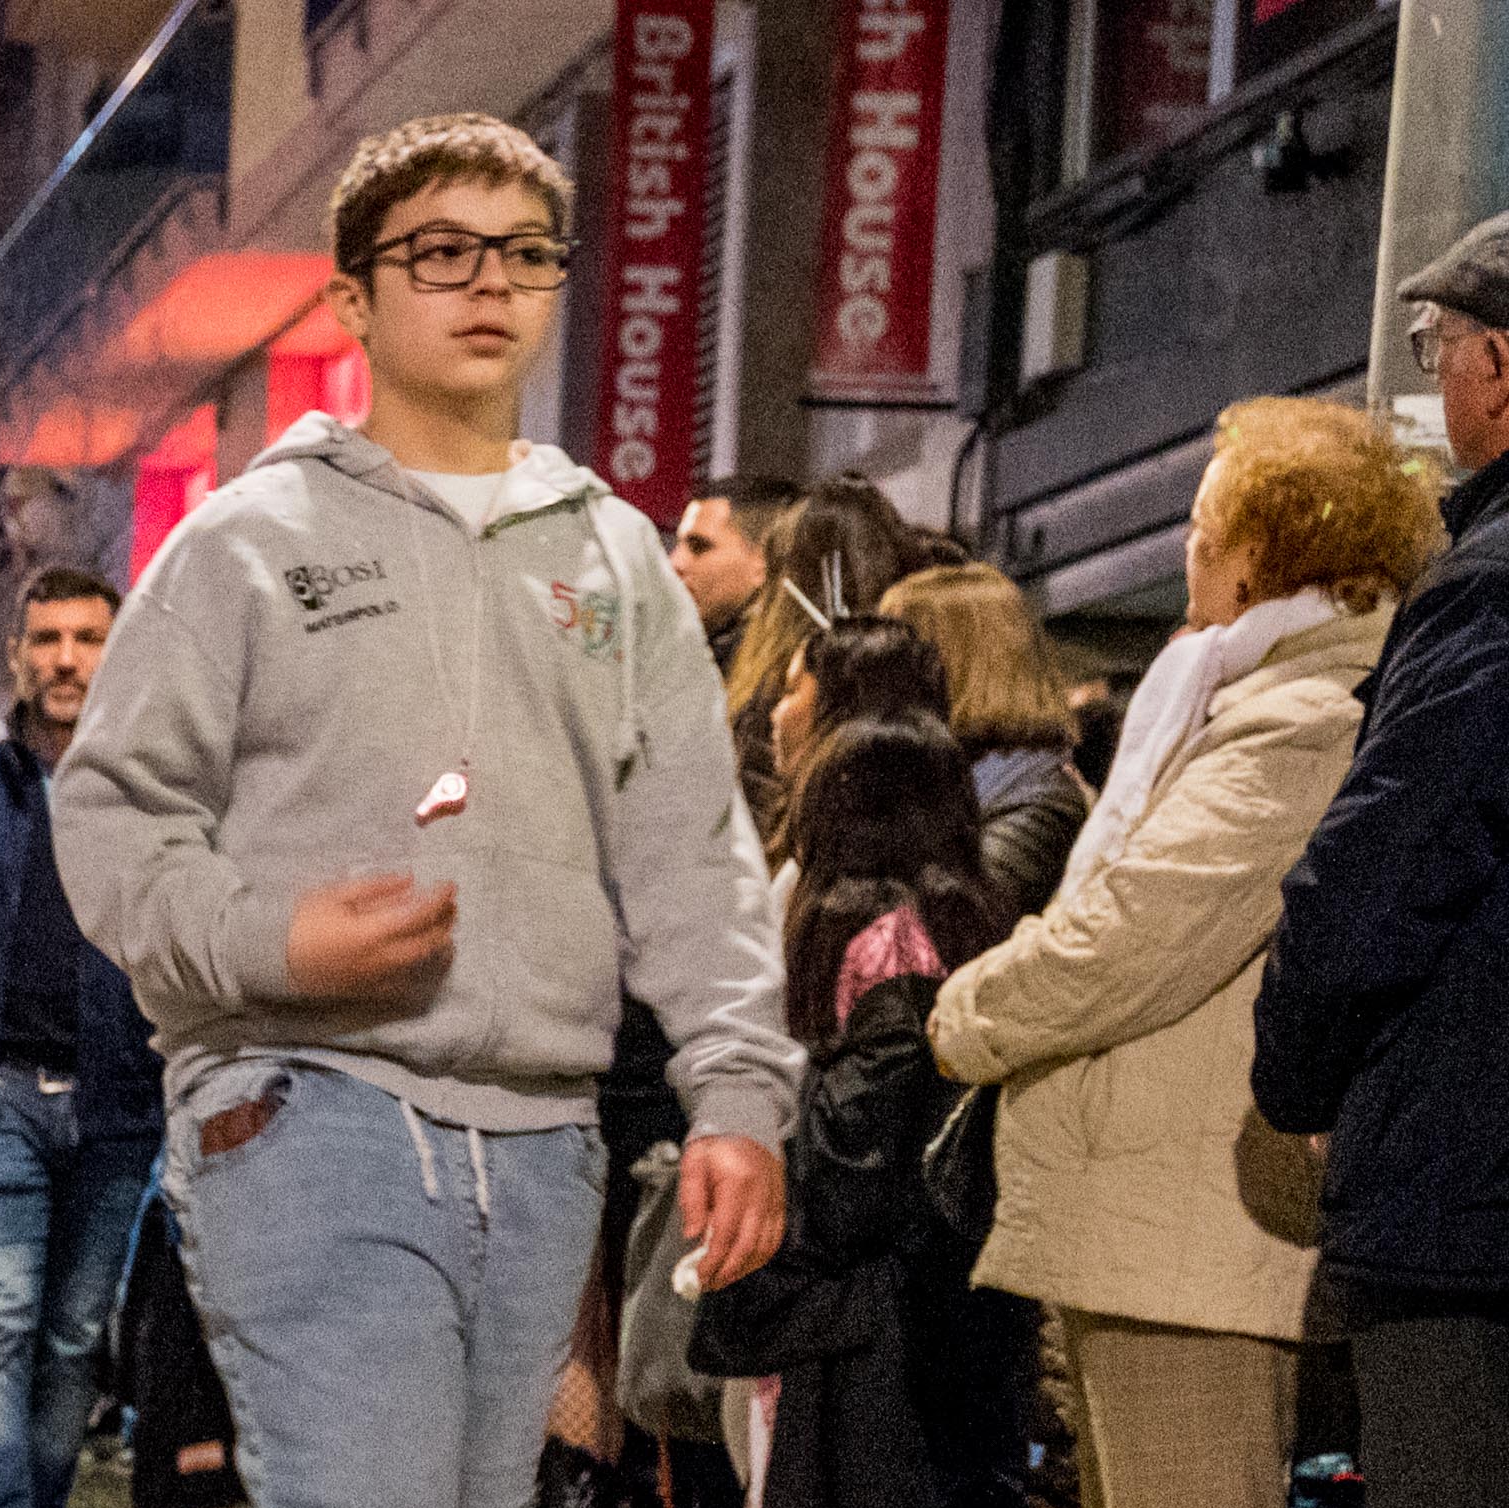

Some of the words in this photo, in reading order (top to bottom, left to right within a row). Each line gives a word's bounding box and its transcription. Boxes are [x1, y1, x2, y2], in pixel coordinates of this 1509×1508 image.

[626, 13, 694, 240] British
[837, 89, 923, 342] House
[611, 265, 682, 482] House
